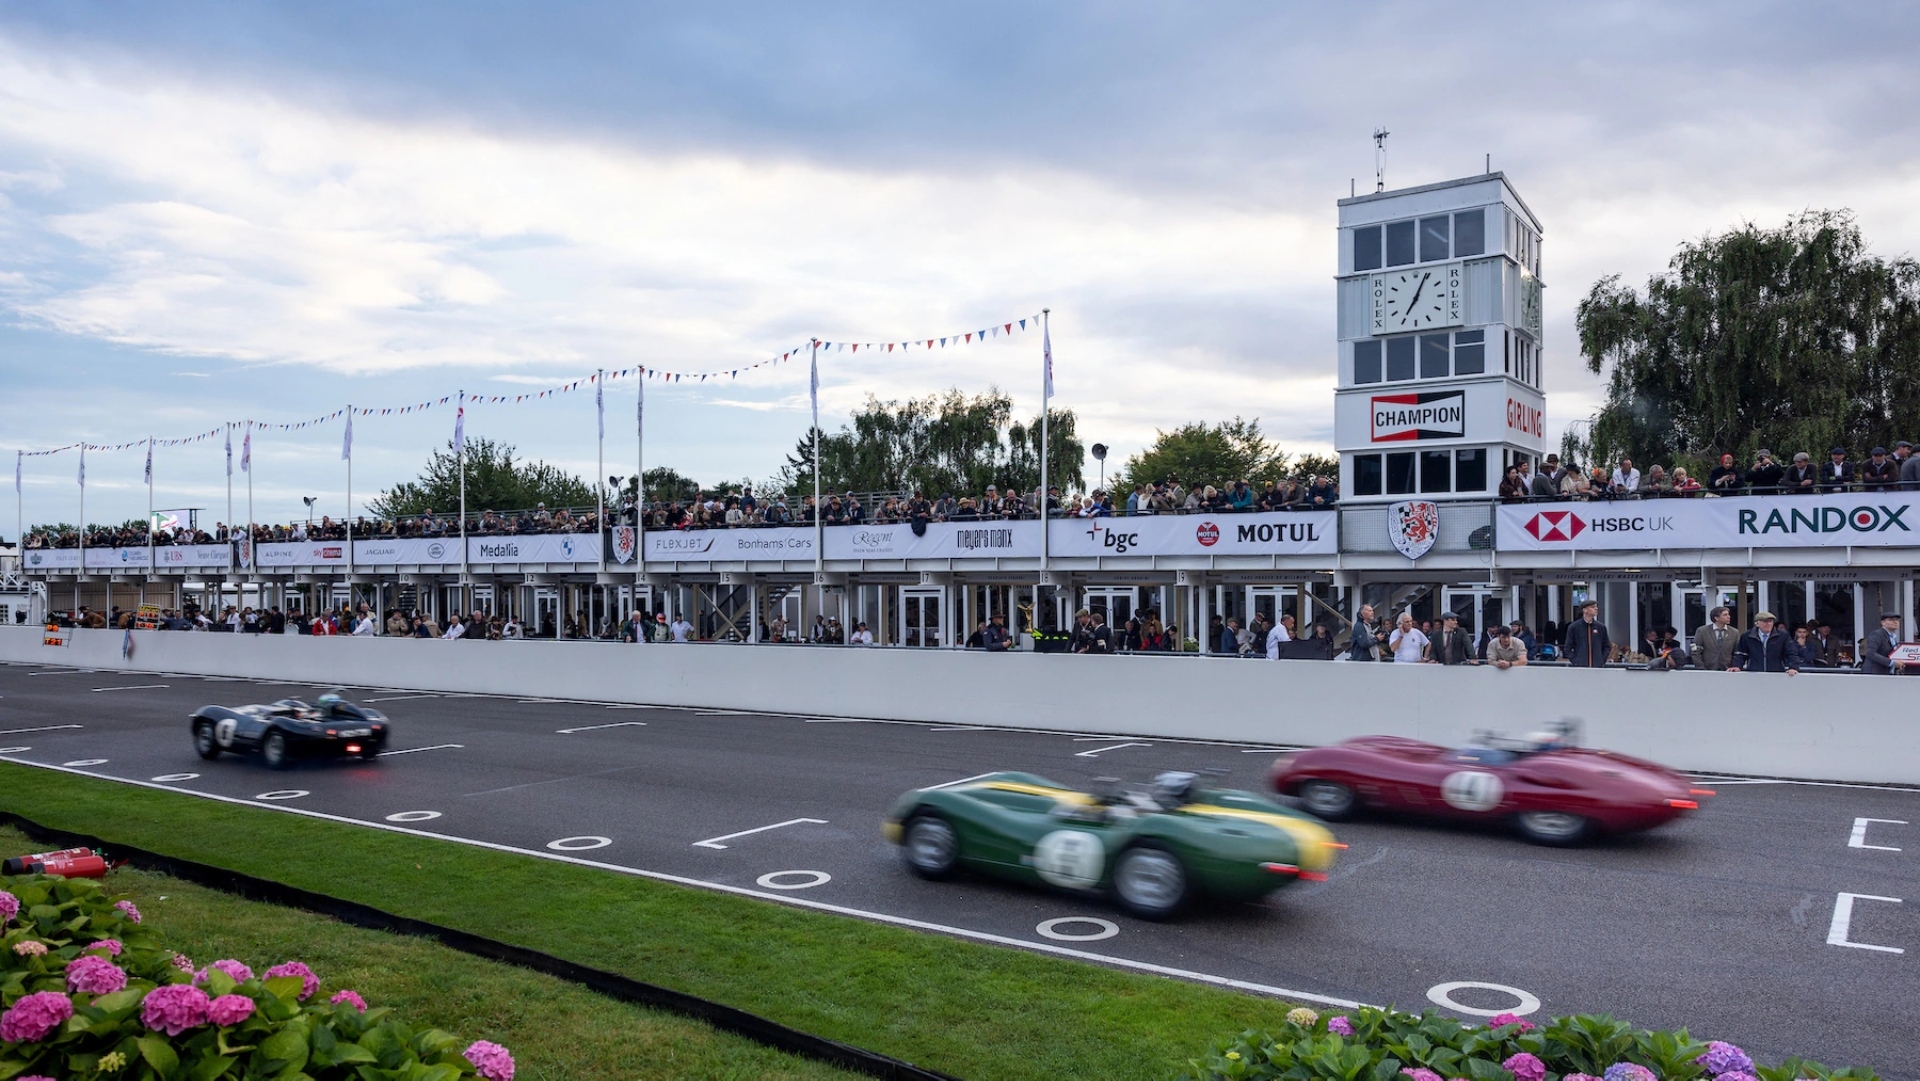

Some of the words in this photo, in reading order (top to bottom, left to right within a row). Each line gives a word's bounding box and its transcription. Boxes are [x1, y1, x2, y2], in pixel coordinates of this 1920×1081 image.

[1450, 269, 1459, 320] ROLEX
[1374, 279, 1383, 328] ROLEX
[1375, 406, 1460, 427] CHAMPION
[1506, 398, 1542, 438] GIRLING
[1592, 517, 1645, 532] HSBC
[1649, 516, 1674, 532] UK
[1738, 504, 1911, 534] RANDOX
[852, 530, 894, 547] Regent
[957, 529, 989, 550] meyers
[990, 528, 1013, 548] manx
[1103, 527, 1139, 553] bgc
[1237, 523, 1320, 543] MOTUL
[170, 550, 183, 561] UBS
[313, 549, 322, 559] sky
[364, 548, 396, 556] JAGUAR
[480, 543, 519, 557] Medallia
[526, 574, 534, 582] 12
[637, 574, 646, 582] 14
[721, 573, 730, 582] 15
[815, 572, 824, 582] 16
[922, 573, 929, 582] 17
[1041, 572, 1049, 583] 18
[1178, 572, 1185, 582] 19
